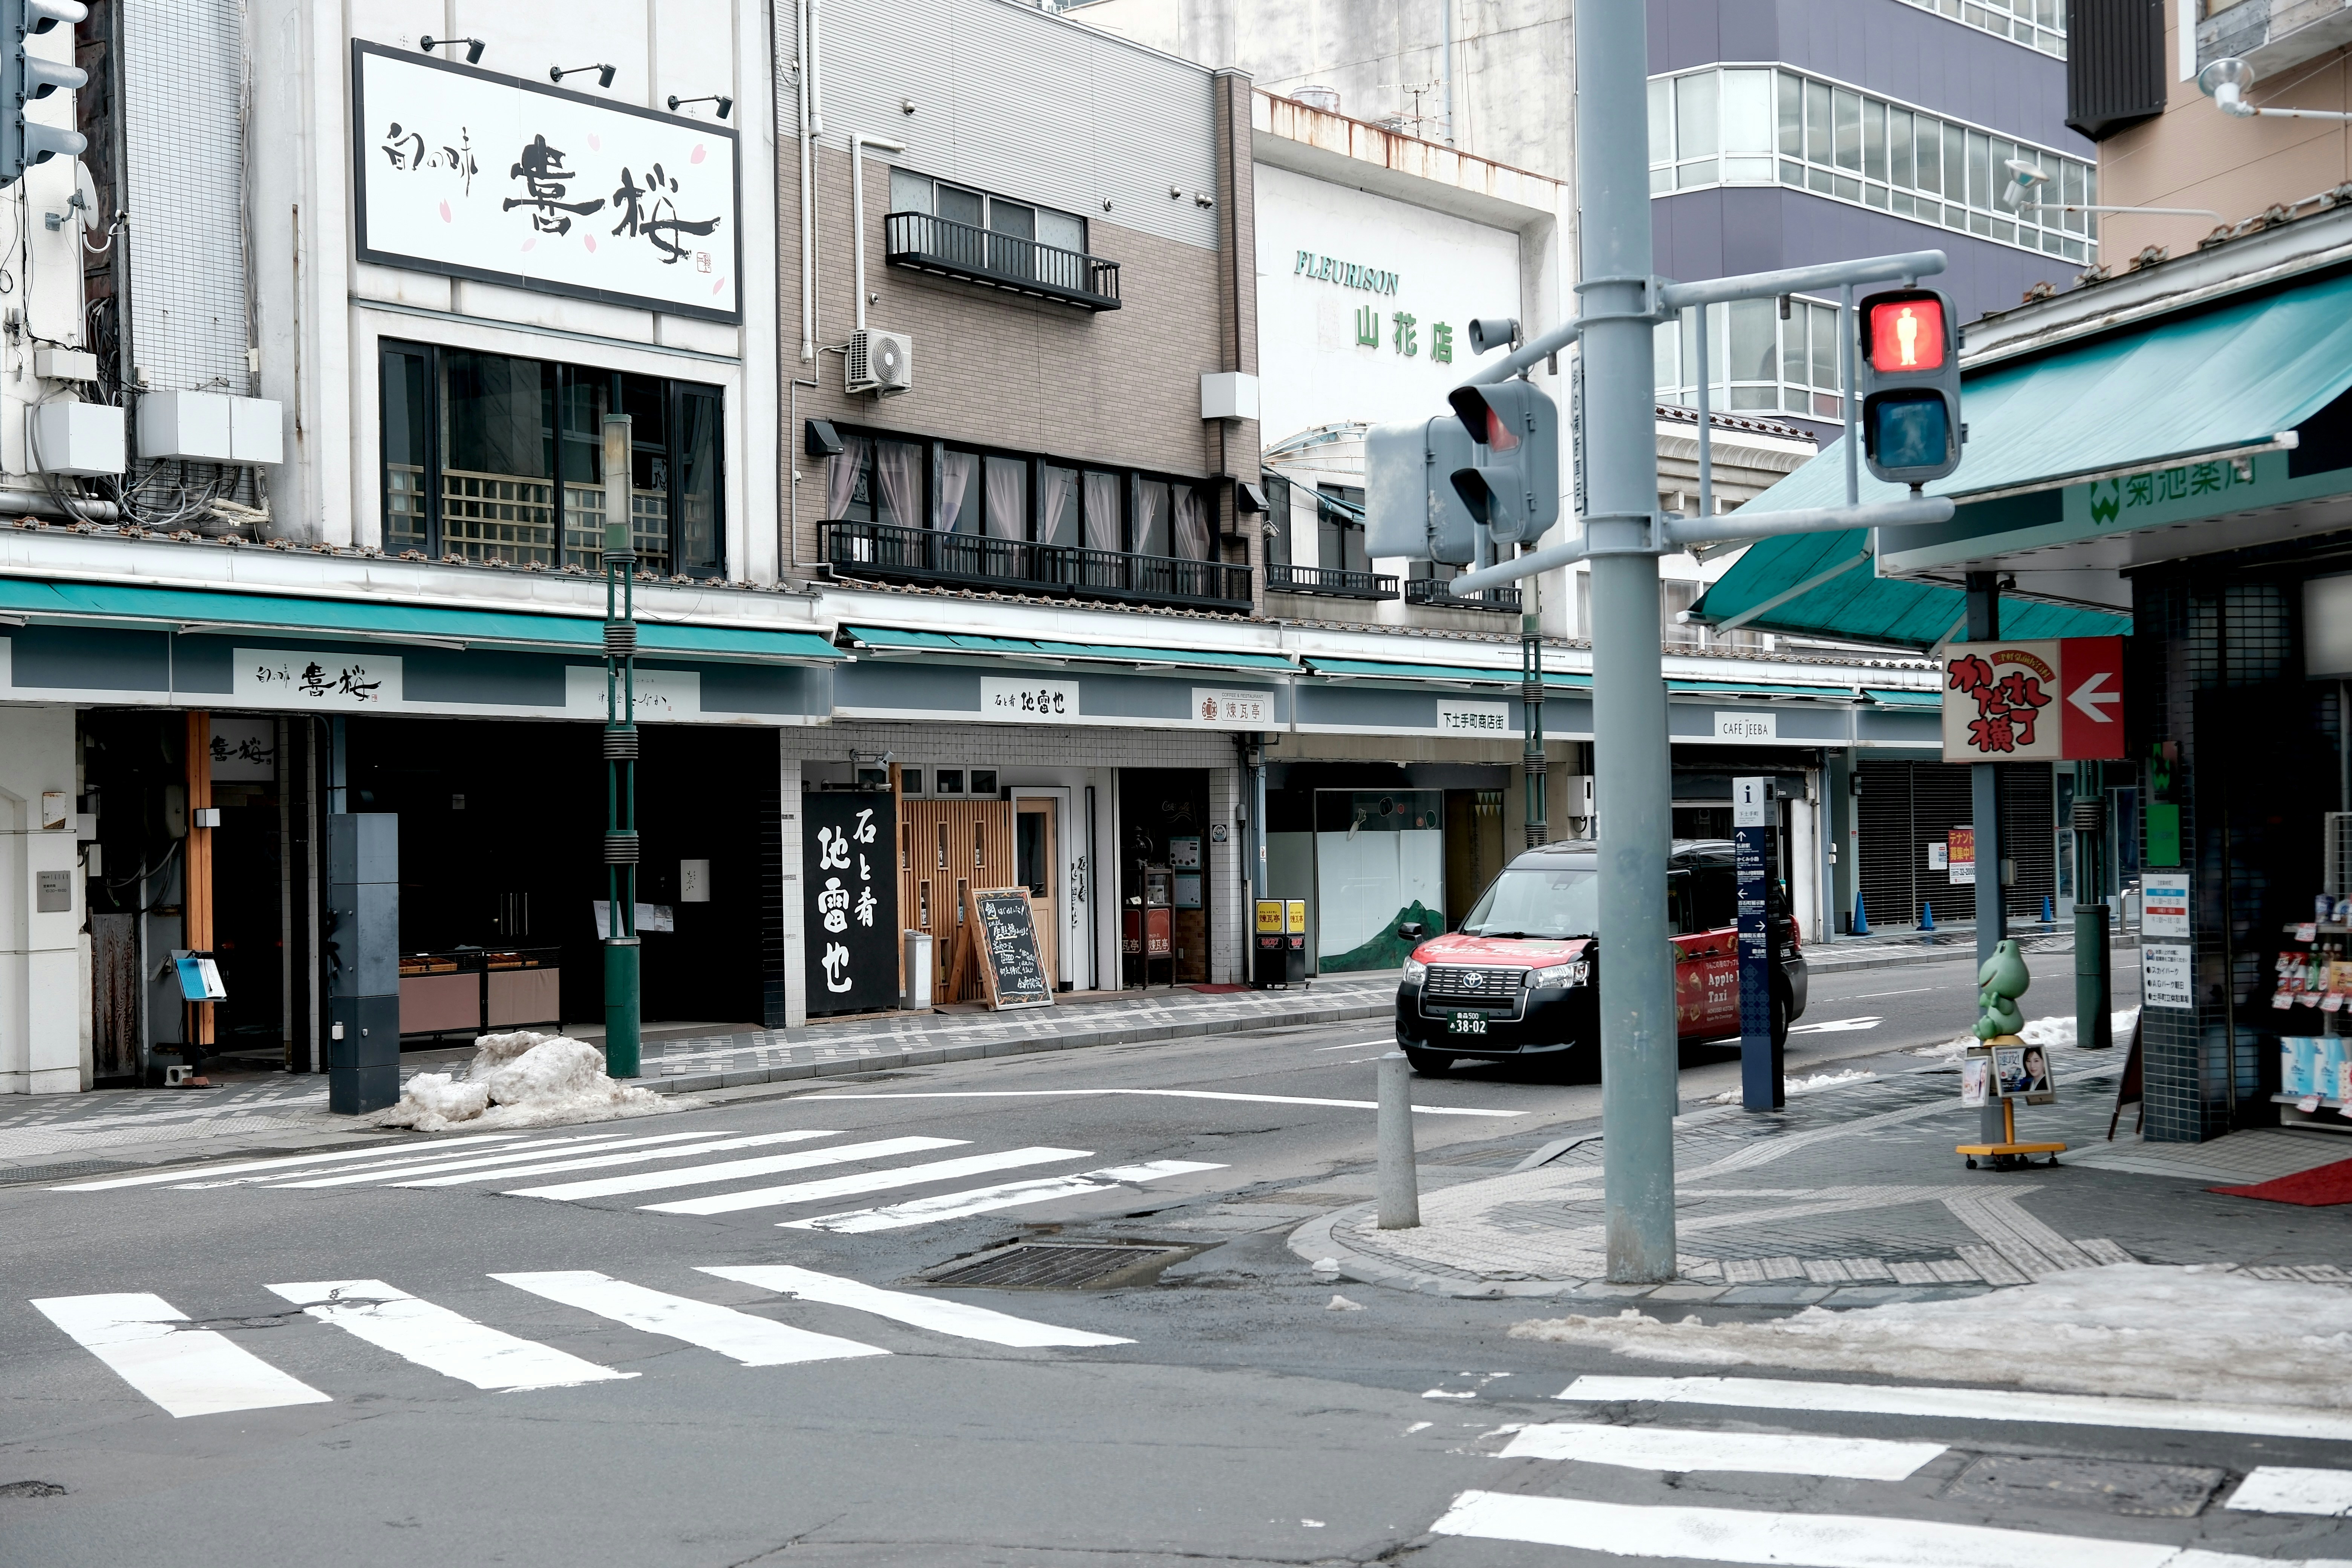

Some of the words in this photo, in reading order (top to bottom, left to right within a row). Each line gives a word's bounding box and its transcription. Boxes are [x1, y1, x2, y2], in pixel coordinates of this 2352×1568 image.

[1294, 250, 1401, 296] FLEURISON
[1355, 305, 1452, 364] 山花店
[1021, 689, 1065, 714] 地雷也
[1226, 702, 1259, 719] 煉瓦亭
[1443, 713, 1504, 729] 下土手町商店街
[1723, 720, 1742, 735] CAFÉ
[1968, 708, 2038, 753] 横丁
[1950, 832, 1974, 844] テナント
[1950, 846, 1974, 860] 募集中!!
[853, 808, 877, 927] 石と肴
[818, 826, 852, 993] 地雷也
[1708, 972, 1733, 987] Apple
[1708, 990, 1727, 1003] Taxi
[1456, 1020, 1486, 1033] 38-02
